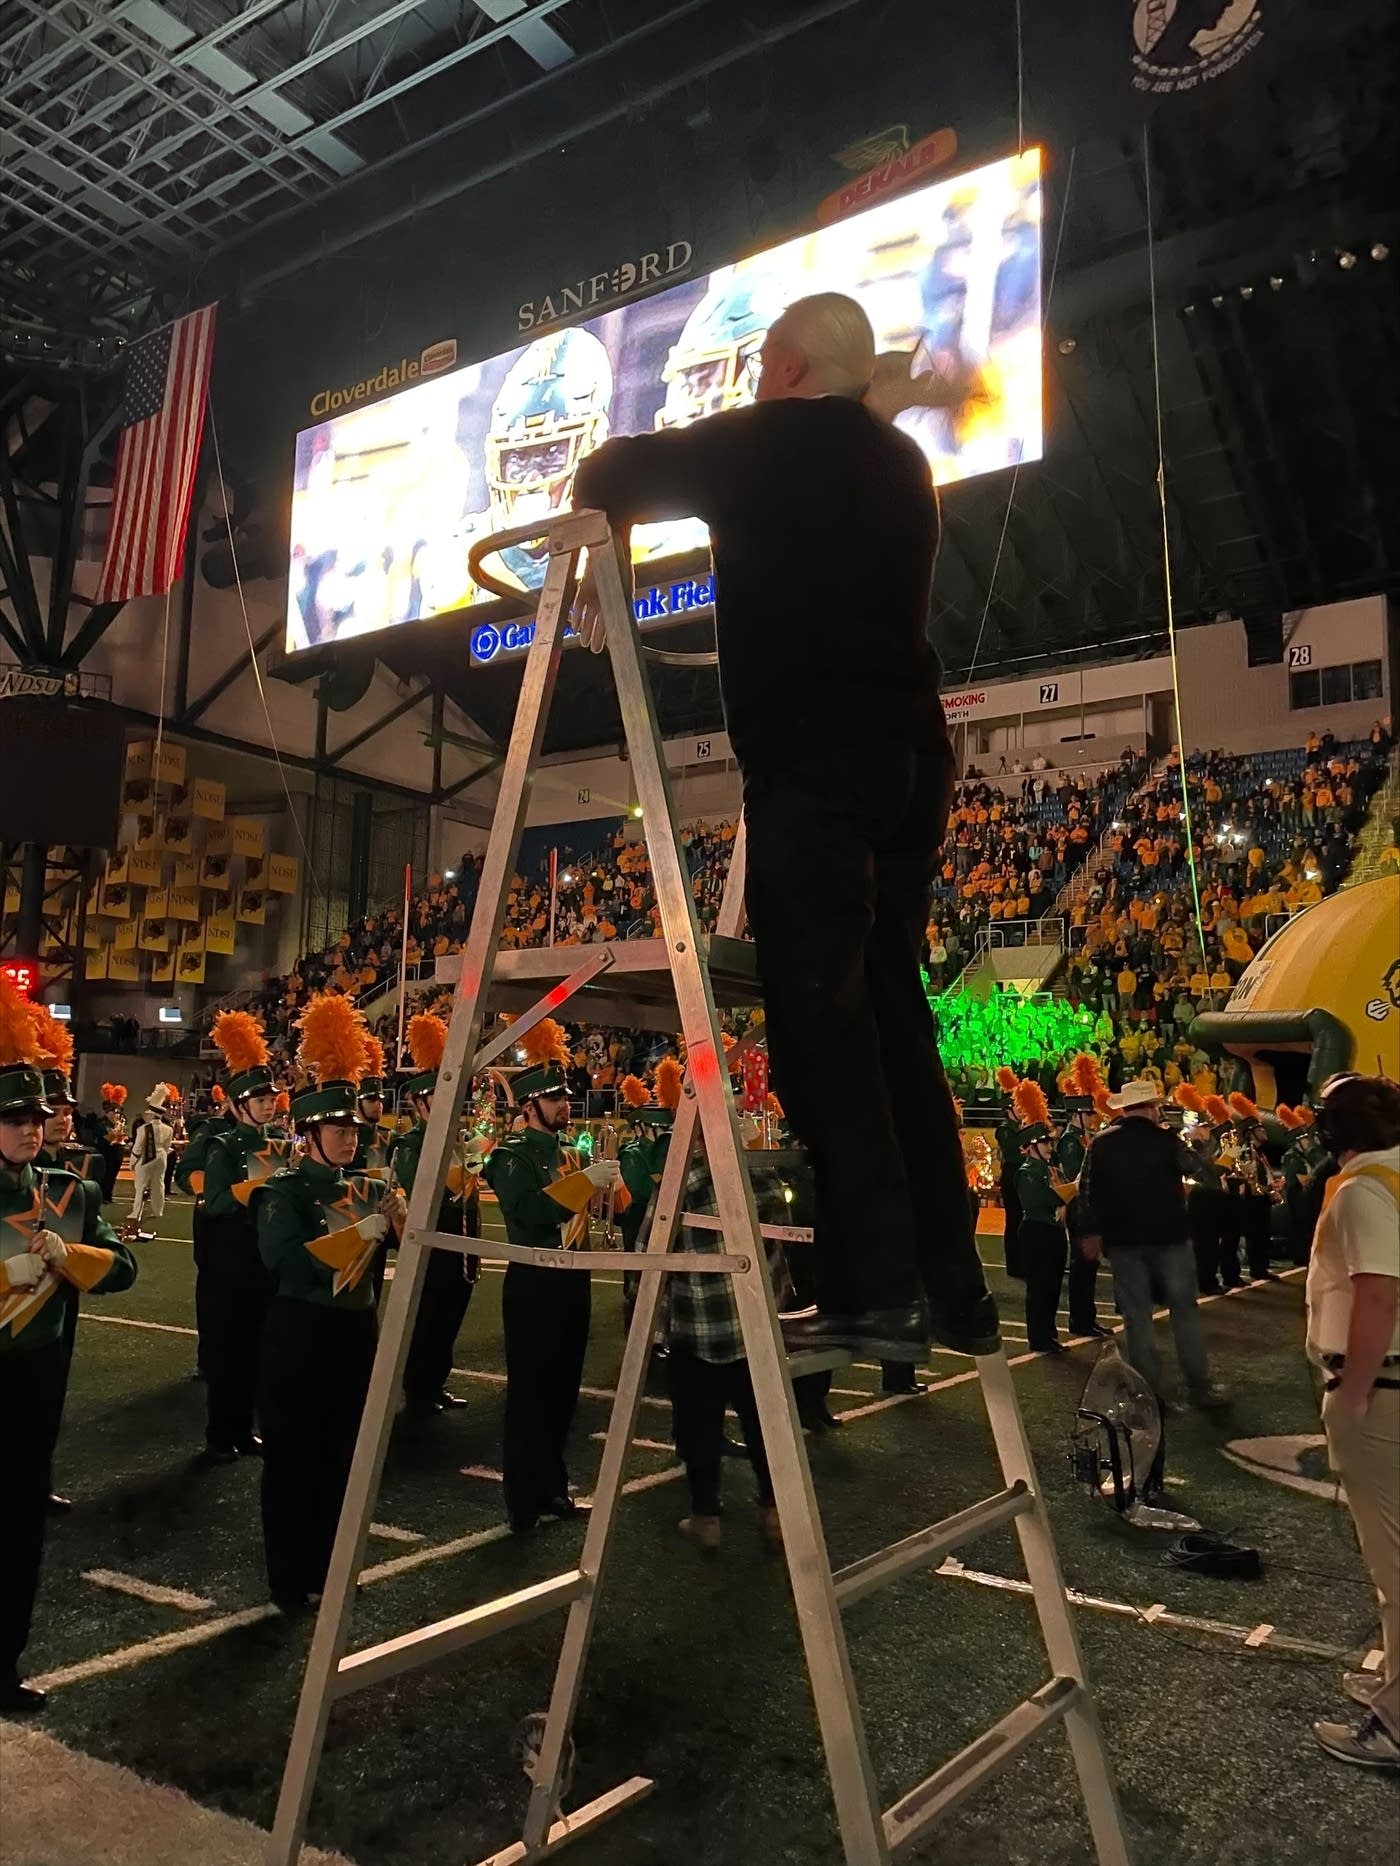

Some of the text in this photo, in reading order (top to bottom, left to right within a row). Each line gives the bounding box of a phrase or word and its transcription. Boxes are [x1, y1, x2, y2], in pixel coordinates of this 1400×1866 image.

[1151, 82, 1173, 93] ARE
[1176, 76, 1199, 91] NOT
[1201, 31, 1264, 82] FORGOTTEN
[518, 241, 692, 331] SANFORD
[310, 358, 419, 416] Cloverdale
[671, 576, 717, 612] Fiel
[1291, 647, 1310, 666] 28
[0, 674, 57, 694] NDSU
[941, 692, 985, 709] MOKING
[1041, 684, 1056, 703] 27
[945, 710, 969, 720] ORTH
[697, 742, 710, 756] 25
[578, 789, 590, 803] 24
[236, 829, 263, 842] NDSU
[271, 866, 297, 879] NDSU
[208, 927, 232, 939] NDSU
